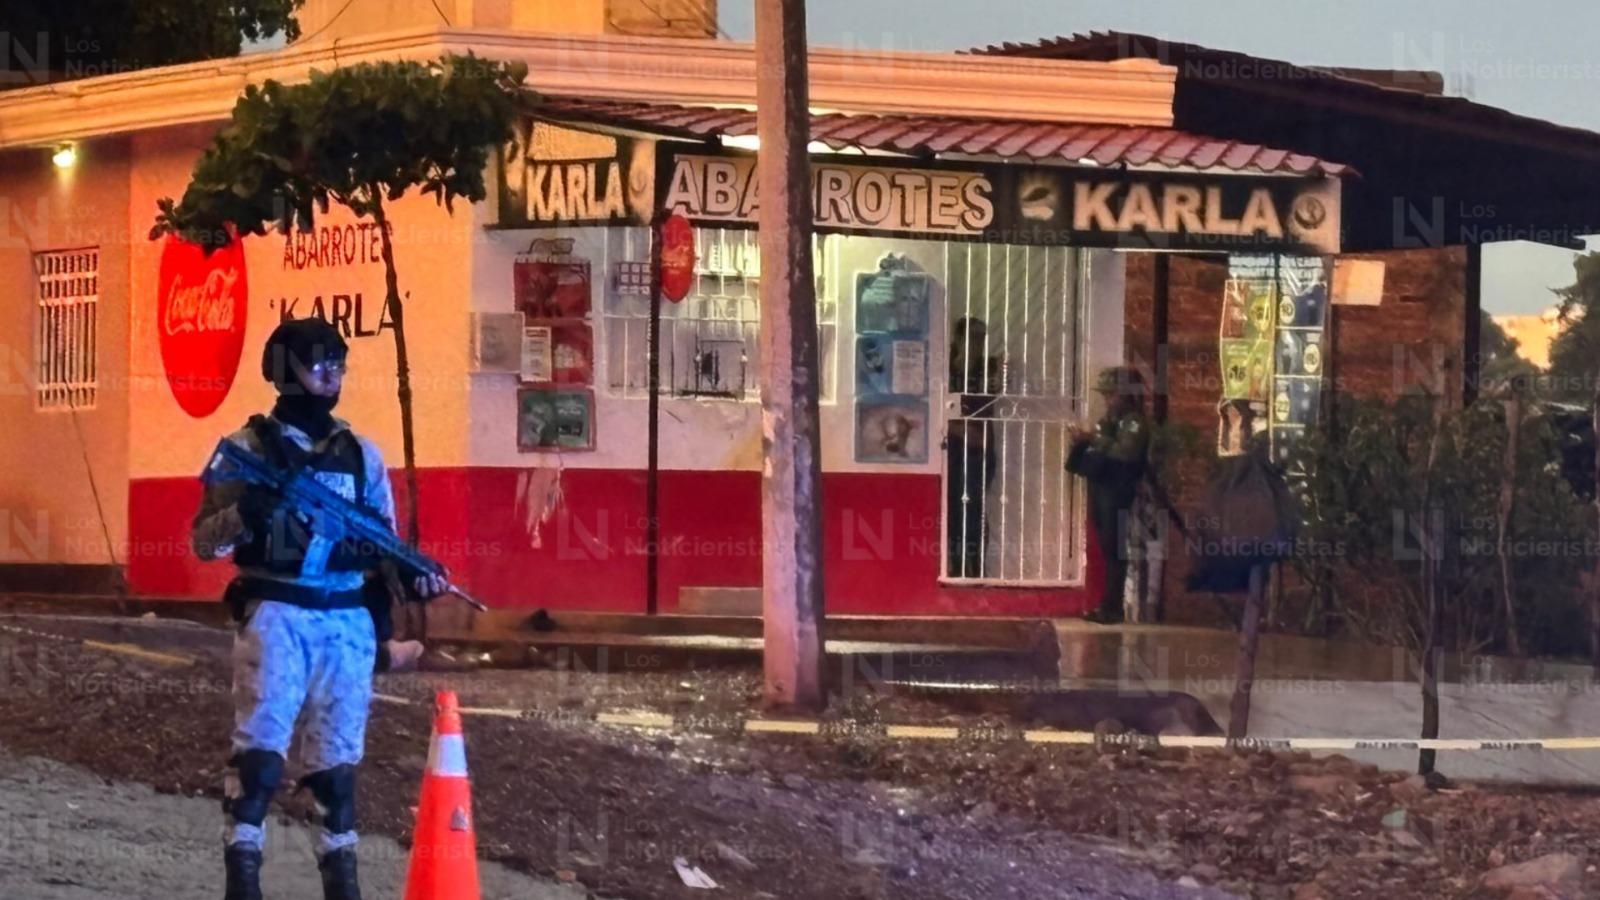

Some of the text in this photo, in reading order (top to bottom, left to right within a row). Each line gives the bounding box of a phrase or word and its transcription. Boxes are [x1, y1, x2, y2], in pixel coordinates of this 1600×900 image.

[526, 161, 626, 220] KARLA
[664, 160, 1283, 238] ABAROTES KARLA
[284, 221, 393, 270] ABARROTE
